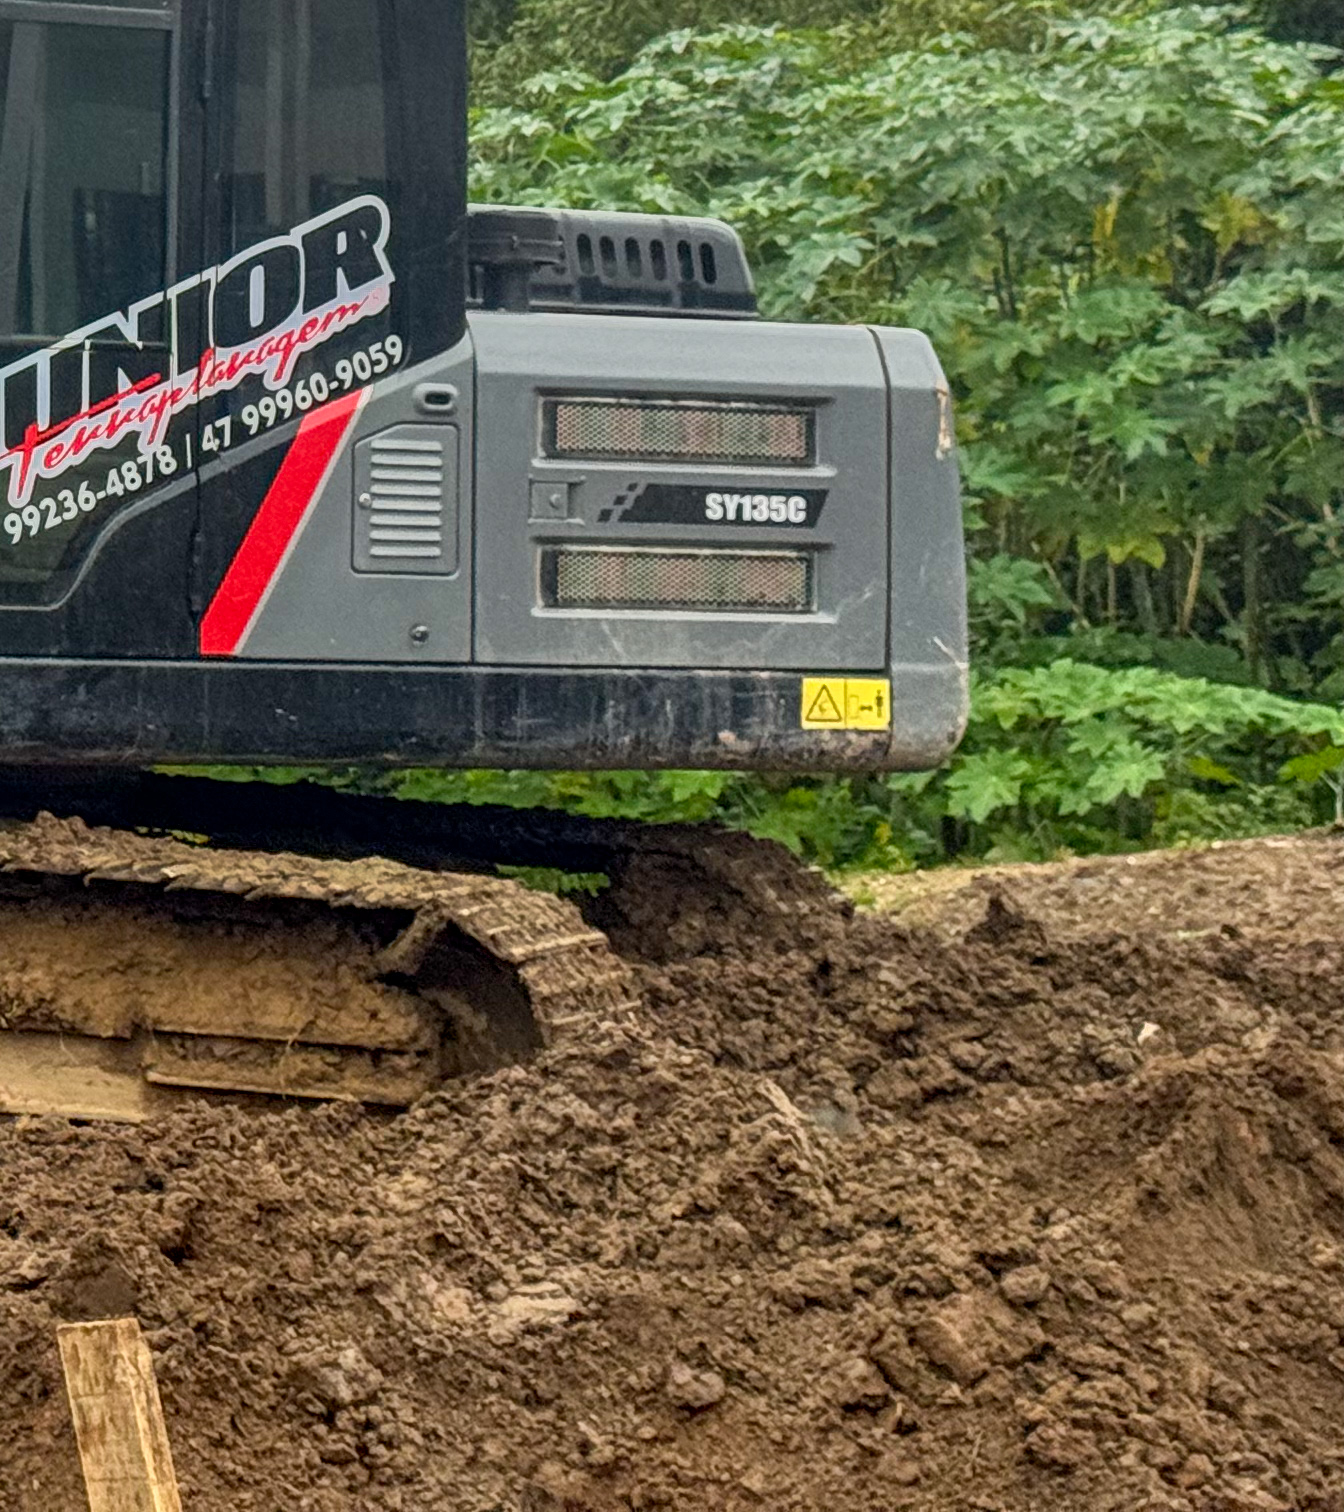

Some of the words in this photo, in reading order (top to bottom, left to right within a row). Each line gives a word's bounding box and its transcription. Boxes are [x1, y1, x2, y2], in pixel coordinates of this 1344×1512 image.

[4, 445, 177, 544] 99236-4878
[202, 415, 231, 452] 47
[242, 335, 403, 435] 99960-9059
[705, 493, 807, 523] SY135C
